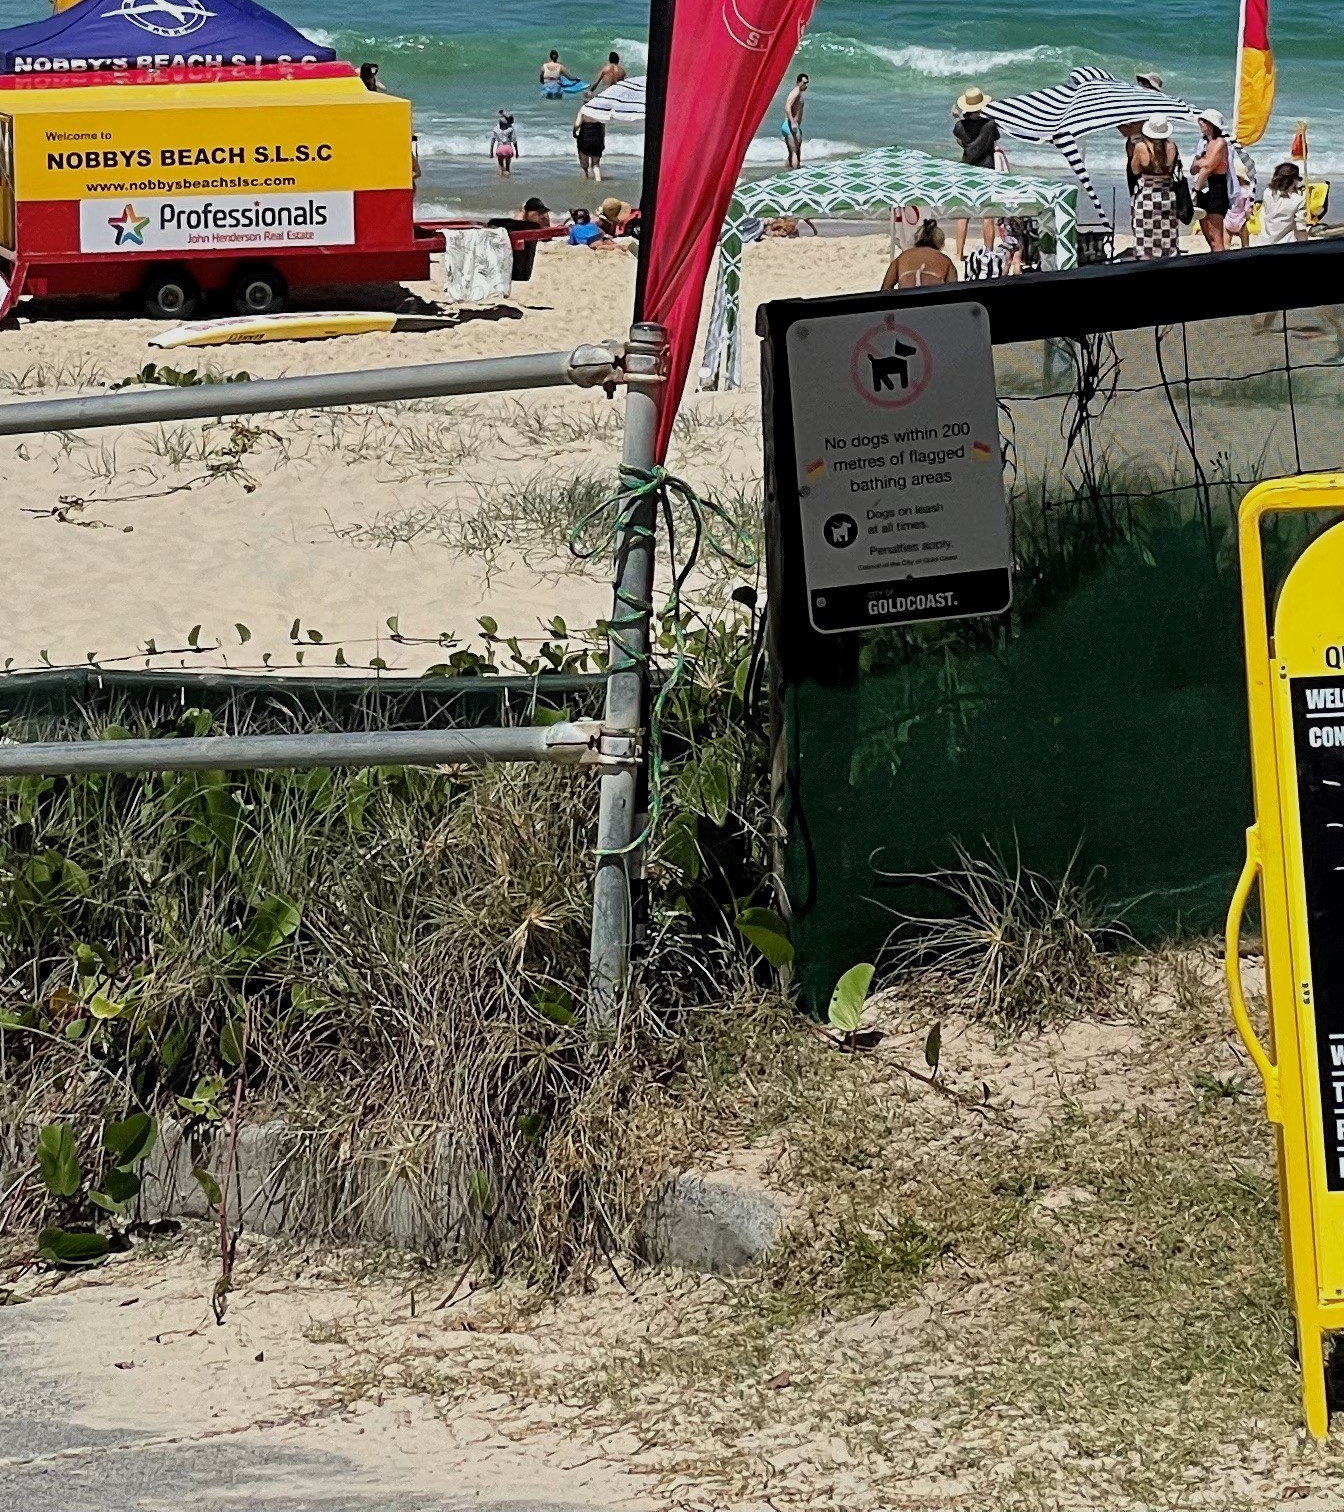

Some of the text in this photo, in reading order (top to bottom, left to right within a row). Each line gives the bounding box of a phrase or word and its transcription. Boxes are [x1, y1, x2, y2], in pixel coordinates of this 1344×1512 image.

[14, 55, 128, 73] NOBBY'S
[136, 53, 222, 74] BEACH
[45, 129, 112, 143] Welcome to
[46, 143, 333, 170] NOBBYS BEACH S.L.S.C
[85, 174, 296, 193] www.nobbysbeachslsc.com
[159, 200, 328, 231] Professionals
[187, 229, 315, 244] John Henderson Real Estate
[824, 421, 971, 451] No dogs within 200
[833, 445, 965, 472] metres of flagged
[850, 471, 953, 493] bathing areas
[866, 503, 945, 521] Dogs on leash
[867, 525, 879, 535] at
[881, 522, 894, 534] all
[869, 543, 920, 556] Penalties
